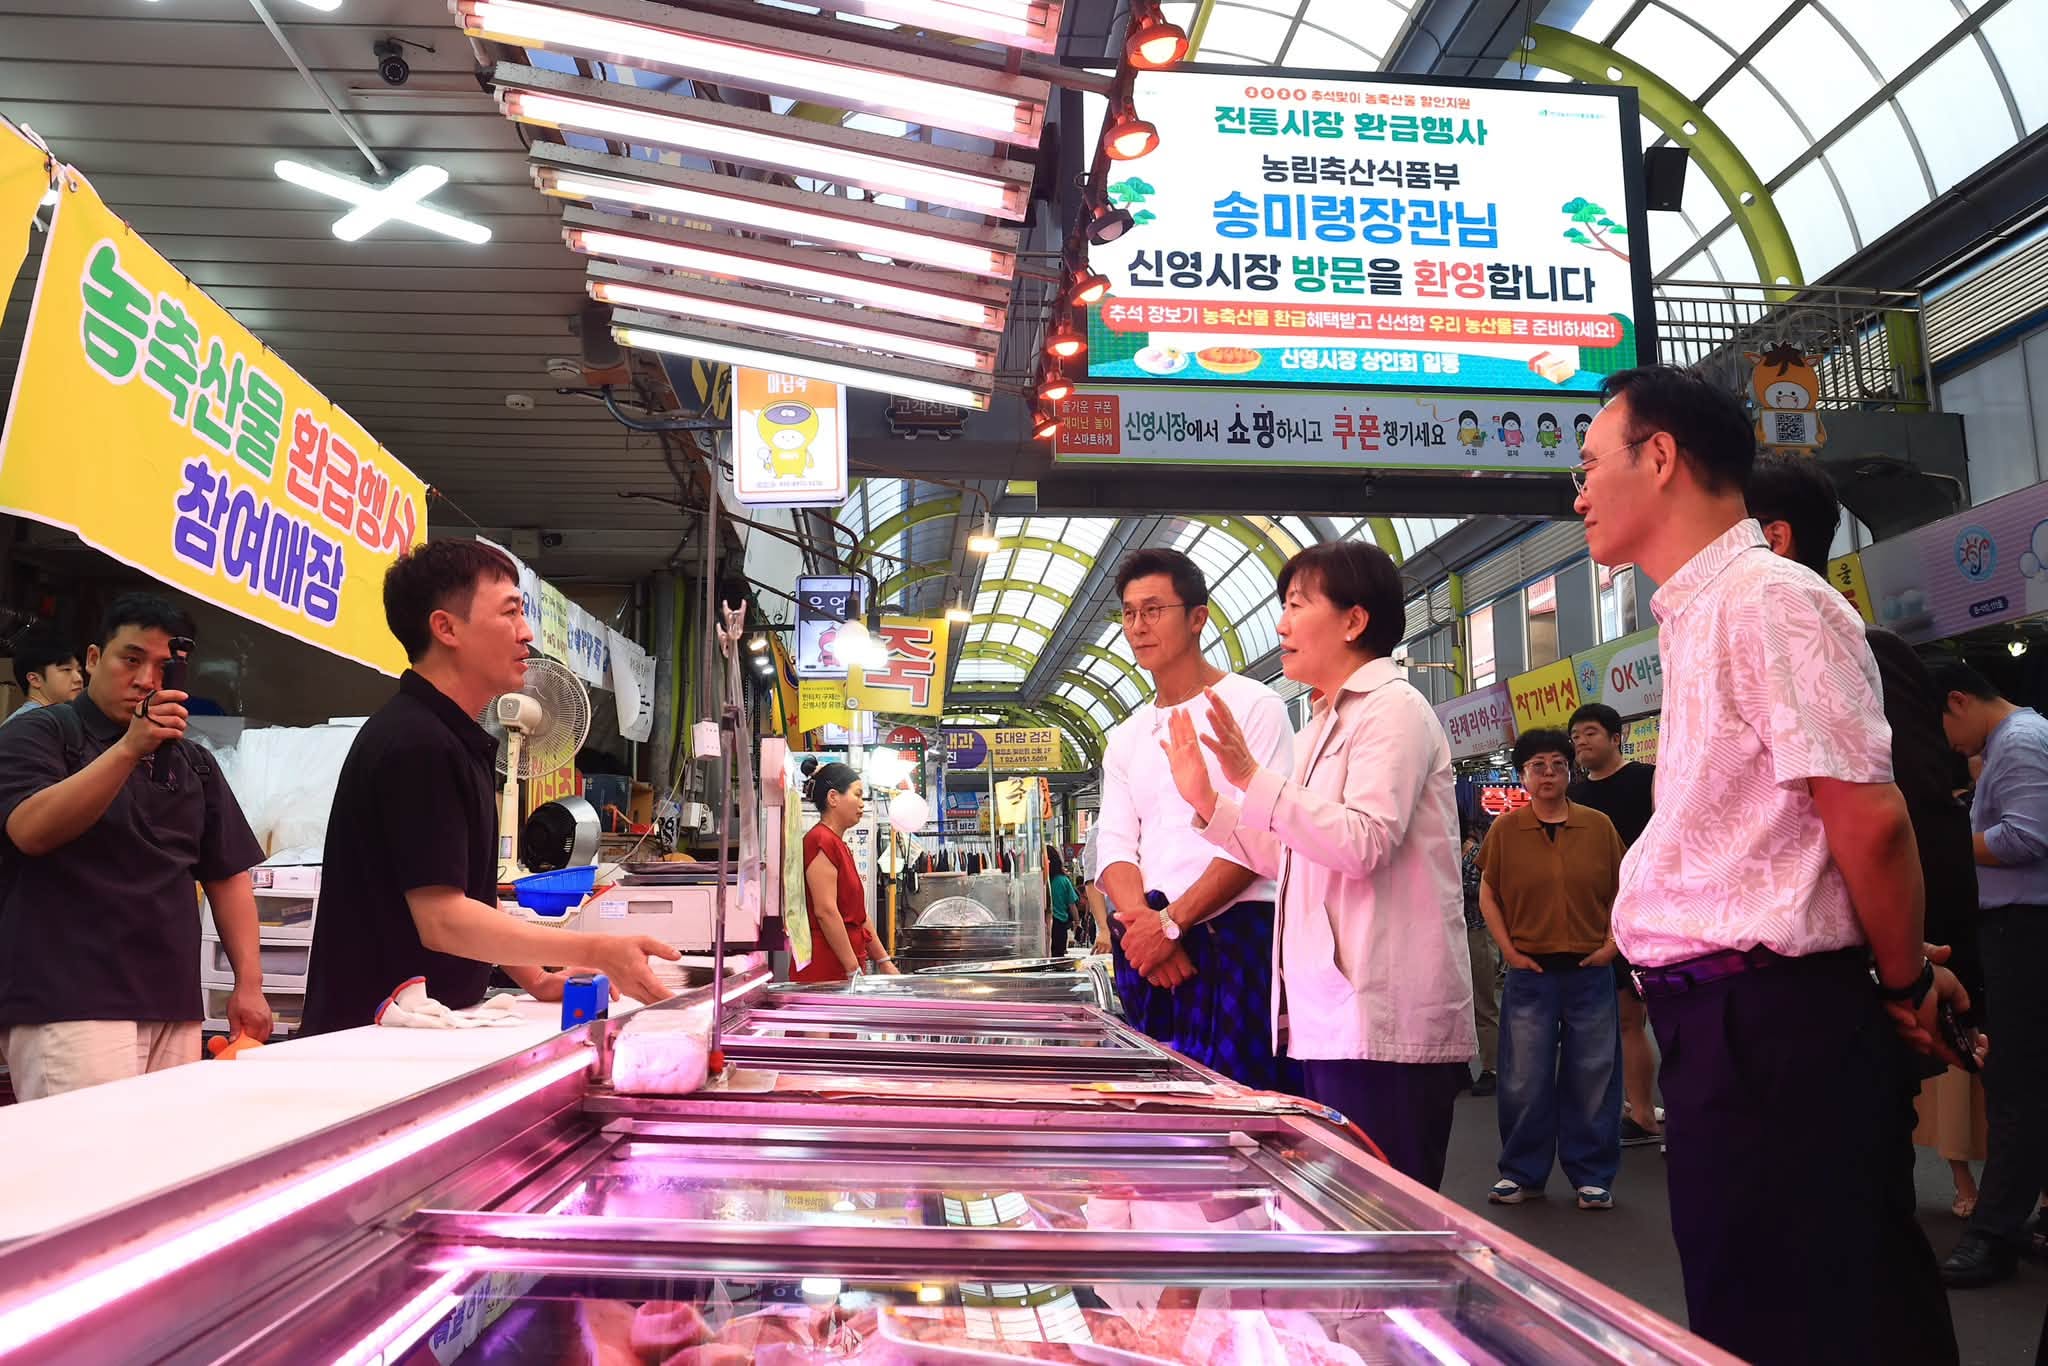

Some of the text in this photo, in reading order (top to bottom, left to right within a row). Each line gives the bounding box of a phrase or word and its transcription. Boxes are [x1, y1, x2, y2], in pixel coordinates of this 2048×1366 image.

[1311, 90, 1360, 104] 추석맞이
[1365, 92, 1415, 106] 농축산물
[1420, 95, 1470, 109] 할인지원
[1215, 105, 1488, 146] 전통시장 환급행사
[1261, 154, 1460, 190] 농림축산식품부
[1213, 190, 1498, 248] 송미령장관님
[1128, 249, 1595, 303] 신영시장 방문을 환영합니다
[1109, 303, 1616, 339] 추석 장보기 농축산물 환급혜택받고 신선한 우리 농산물로 준비하세요!
[1279, 348, 1460, 374] 신영시장 상인회 일동
[82, 244, 416, 556] 농축산물 환급행사
[1062, 400, 1112, 414] 즐거운 쿠폰
[1062, 415, 1112, 430] 재미난 놀이
[1062, 432, 1113, 447] 더 스마트하게
[1125, 410, 1219, 443] 신영시장에서
[1226, 410, 1324, 449] 쇼핑하시고
[174, 461, 344, 623] 참여매장
[995, 731, 1052, 744] 5대암 검진
[1448, 702, 1513, 745] 란제리하우스
